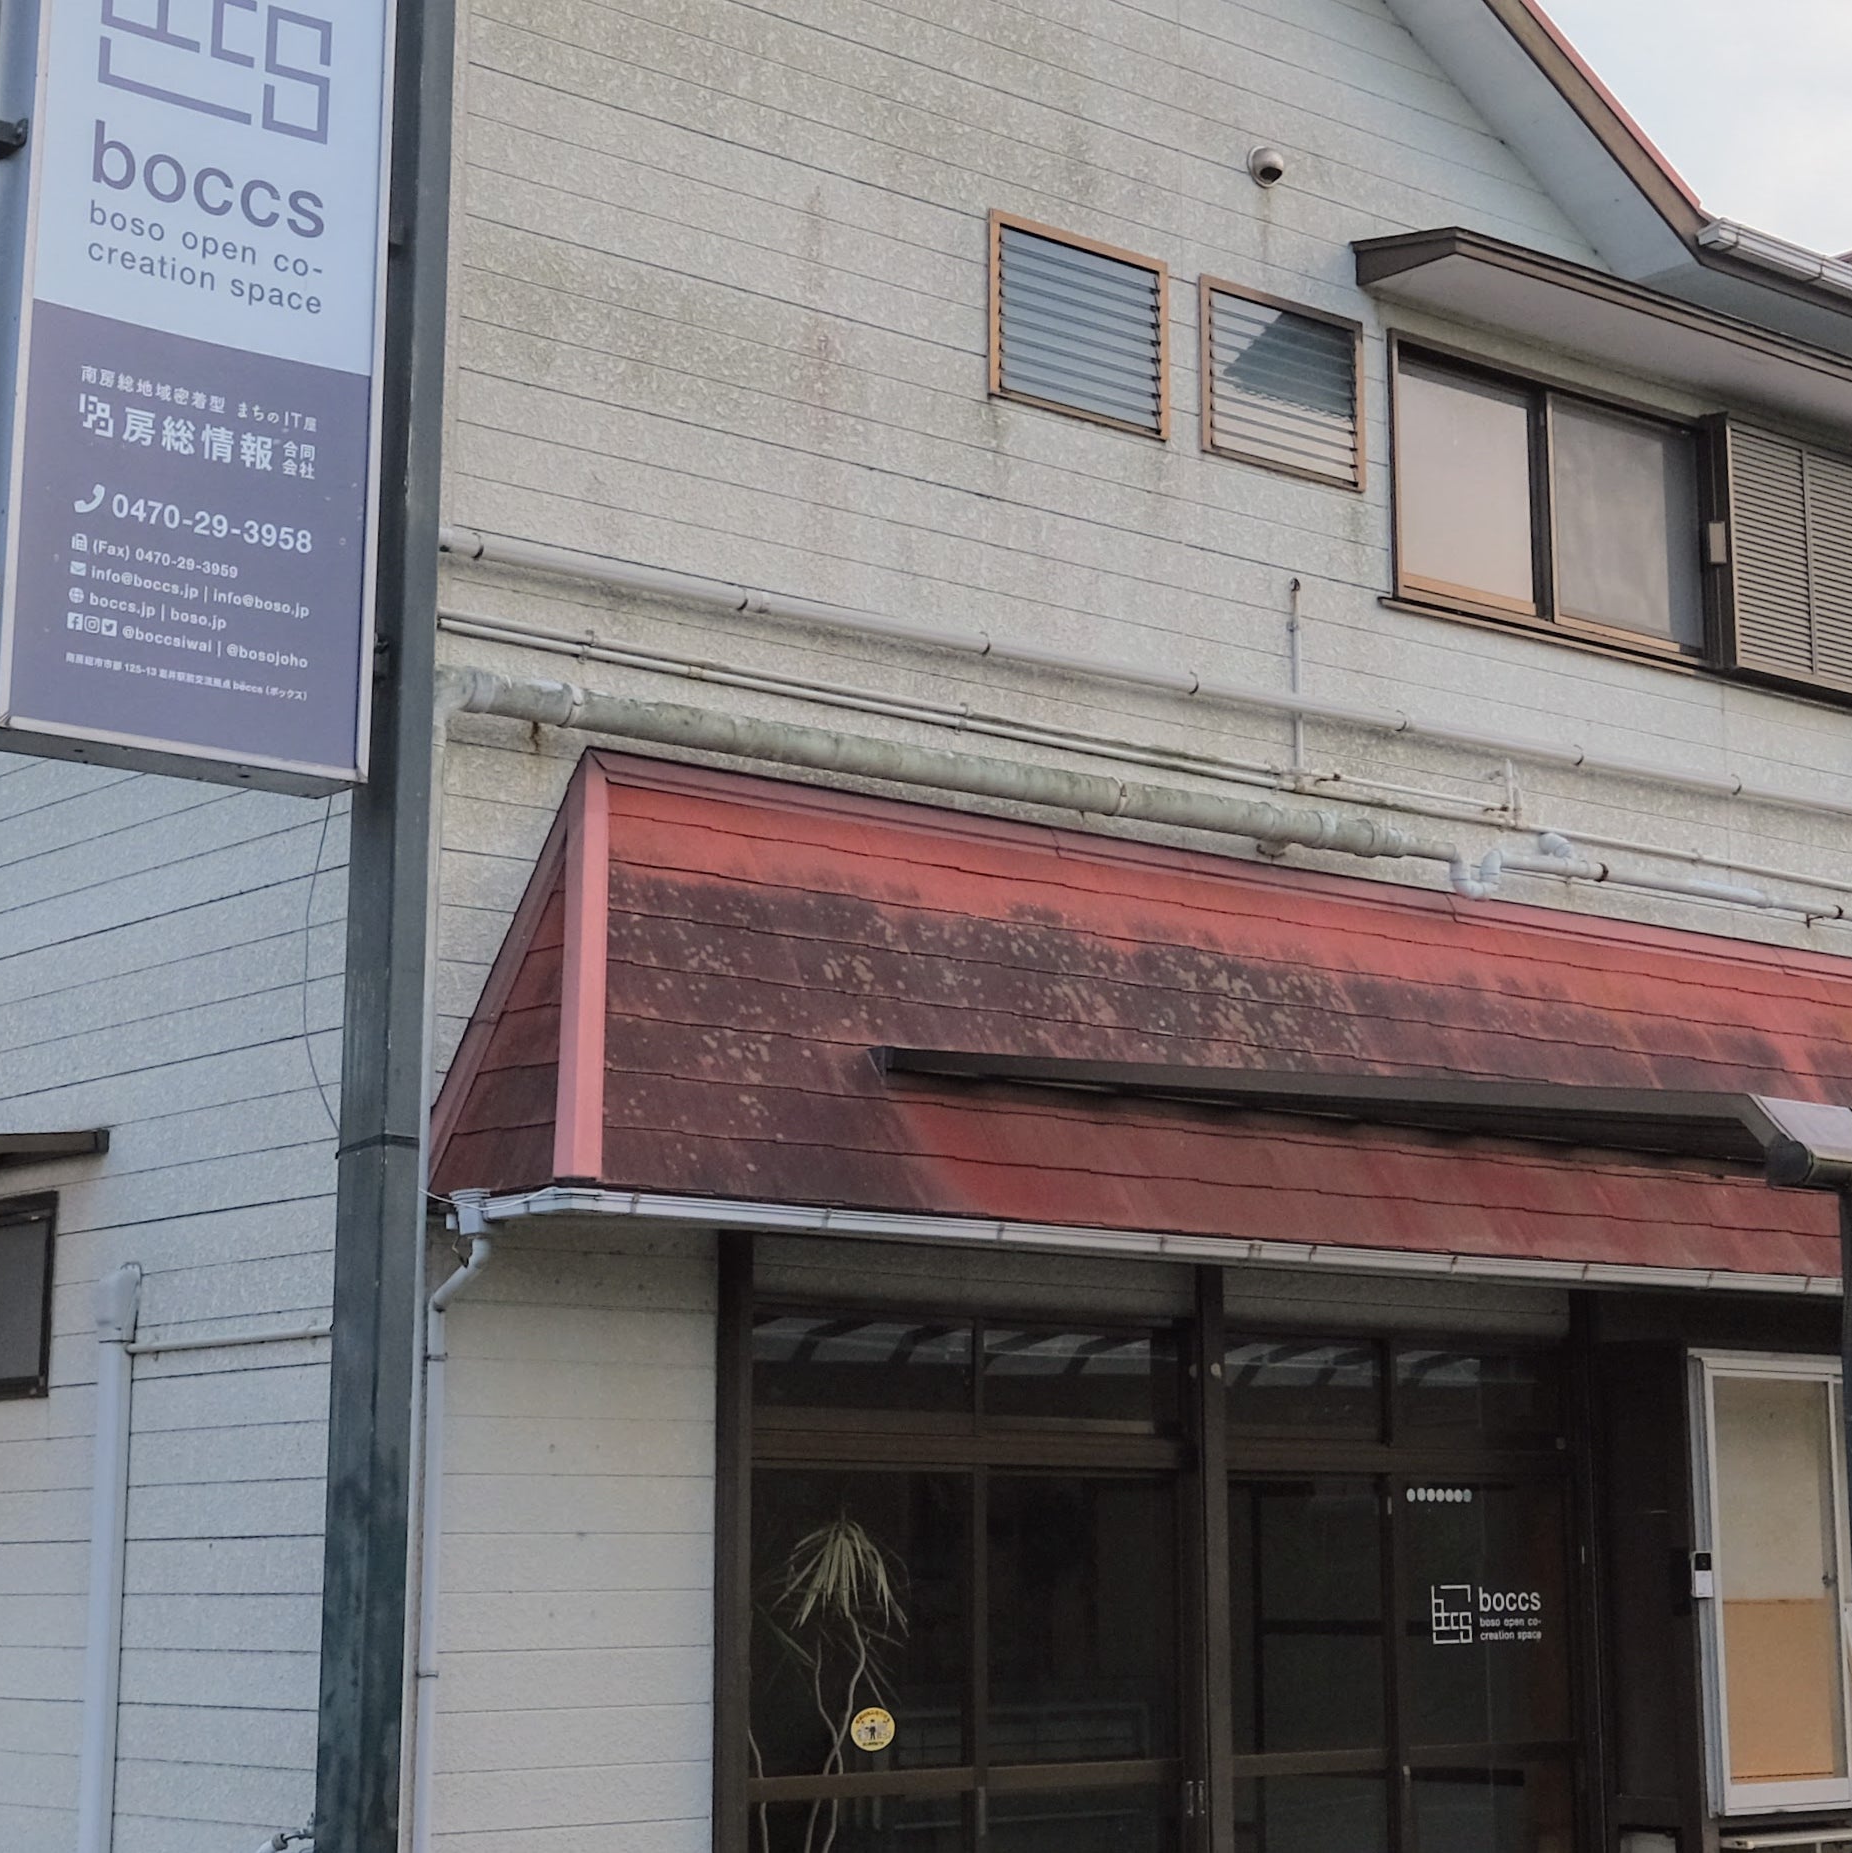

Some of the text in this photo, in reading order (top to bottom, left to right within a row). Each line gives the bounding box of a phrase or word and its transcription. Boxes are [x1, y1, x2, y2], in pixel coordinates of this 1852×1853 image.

[92, 119, 325, 238] boccs
[90, 200, 323, 278] boso open co-
[88, 241, 322, 315] creation space
[81, 365, 317, 432] 南房総地域密着型 まちのIT屋
[122, 406, 273, 471] 房総情報
[282, 440, 316, 461] 合同
[282, 459, 315, 480] 会社
[112, 494, 312, 553] 0470-29-3958
[92, 539, 238, 579] (Fax) 0470-29-3959
[89, 592, 227, 630] boccs.jp boso.jp
[91, 566, 310, 619] info@boccs.jp info@boso.jp
[122, 626, 308, 669] @boccsiwai @bosojoho
[1479, 1586, 1541, 1612] boccs
[1480, 1617, 1541, 1629] boso open co-
[1480, 1630, 1542, 1641] creation space
